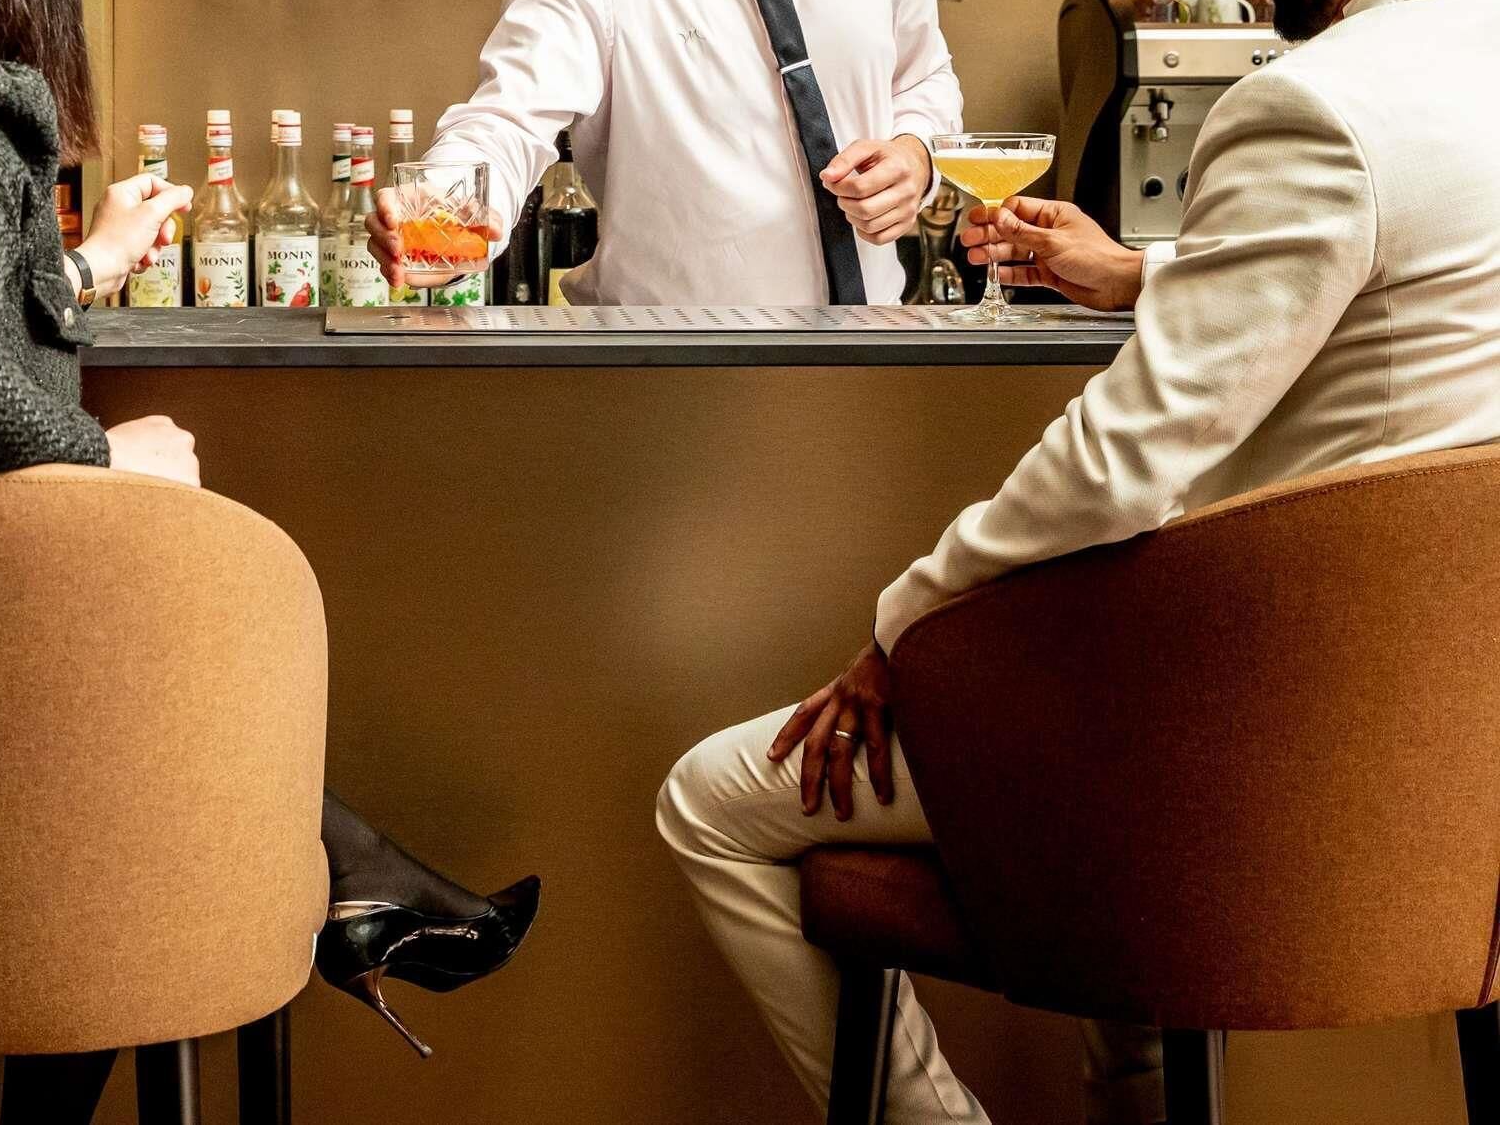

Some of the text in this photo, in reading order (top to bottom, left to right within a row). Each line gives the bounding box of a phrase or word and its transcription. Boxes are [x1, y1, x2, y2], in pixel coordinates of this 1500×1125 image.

[267, 250, 313, 260] MONIN
[198, 257, 243, 267] MONIN
[340, 259, 380, 269] MONI
